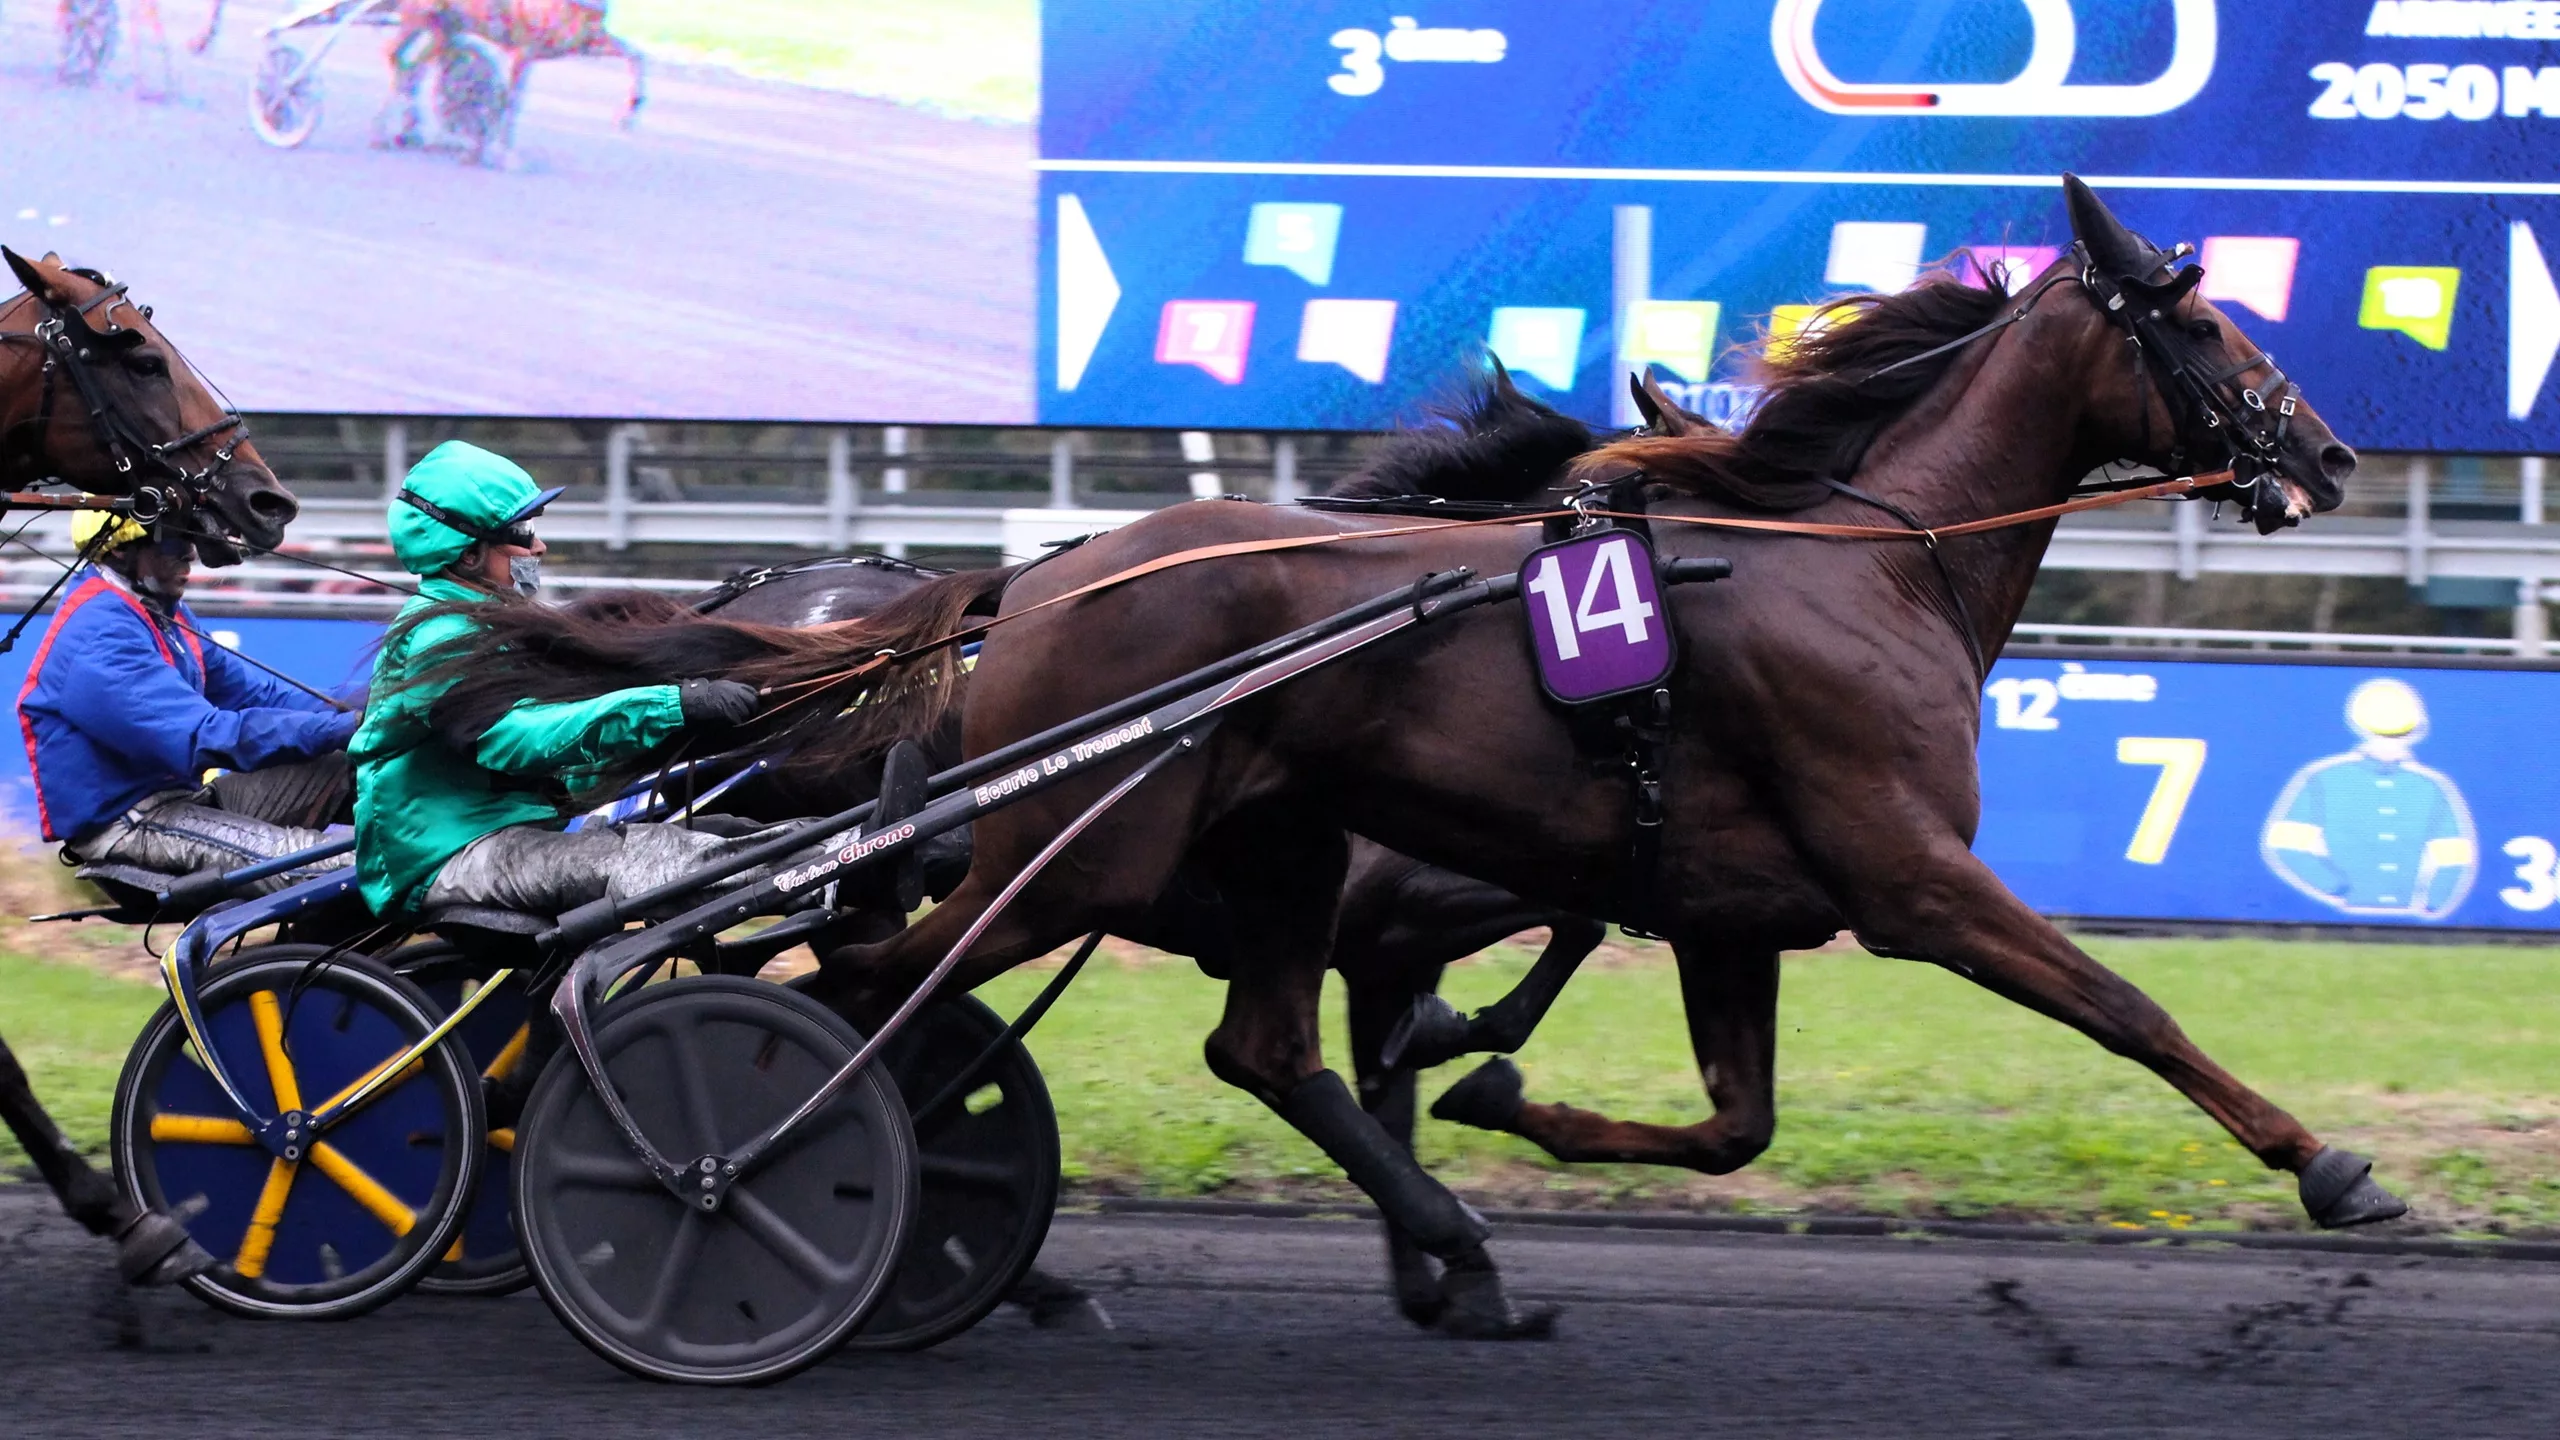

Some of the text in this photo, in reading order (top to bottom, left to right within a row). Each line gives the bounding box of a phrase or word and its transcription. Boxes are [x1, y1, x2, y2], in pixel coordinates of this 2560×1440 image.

[2307, 61, 2500, 121] 2050
[1276, 212, 1316, 253] 5
[1528, 538, 1655, 661] 14
[975, 716, 1153, 807] Ecurie Le Tremont
[2116, 736, 2208, 865] 7
[773, 823, 916, 892] Custom Chrono
[2499, 835, 2560, 912] 3
